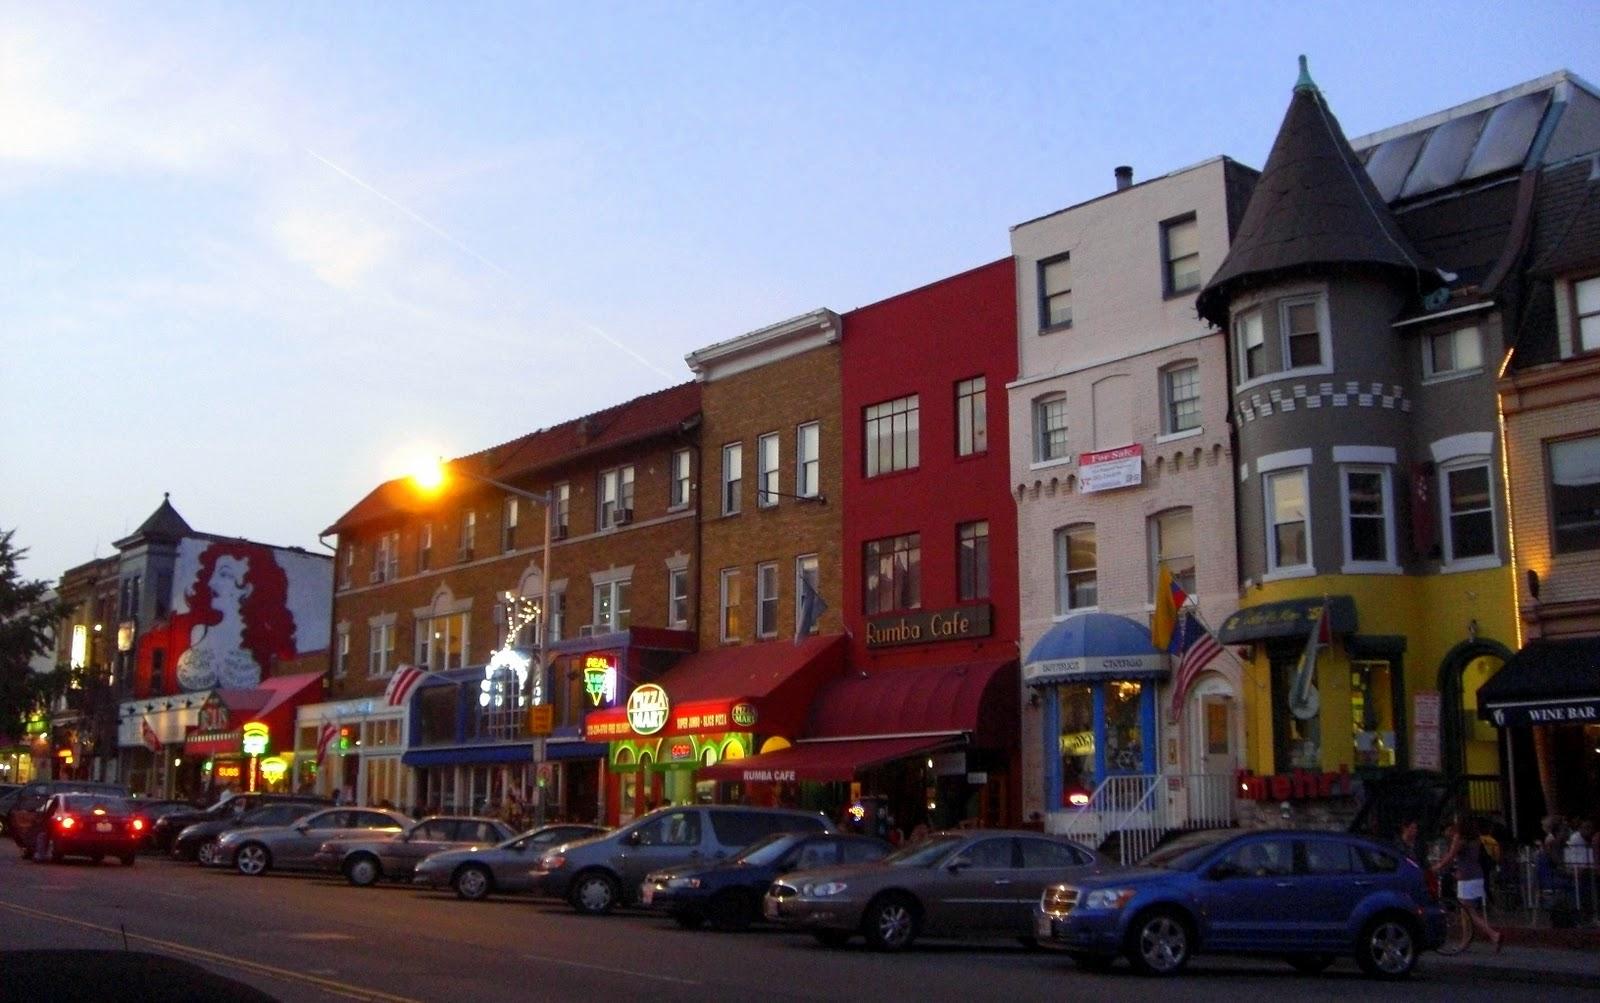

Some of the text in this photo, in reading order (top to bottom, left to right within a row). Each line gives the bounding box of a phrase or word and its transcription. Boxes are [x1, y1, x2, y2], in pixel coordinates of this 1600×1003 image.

[1091, 448, 1132, 463] For Sale
[866, 611, 969, 644] Rumba Cafe
[633, 690, 666, 709] PIZZA
[633, 710, 665, 729] MART
[1529, 706, 1597, 720] WINE BAR
[743, 770, 796, 780] RUMBA CAFE
